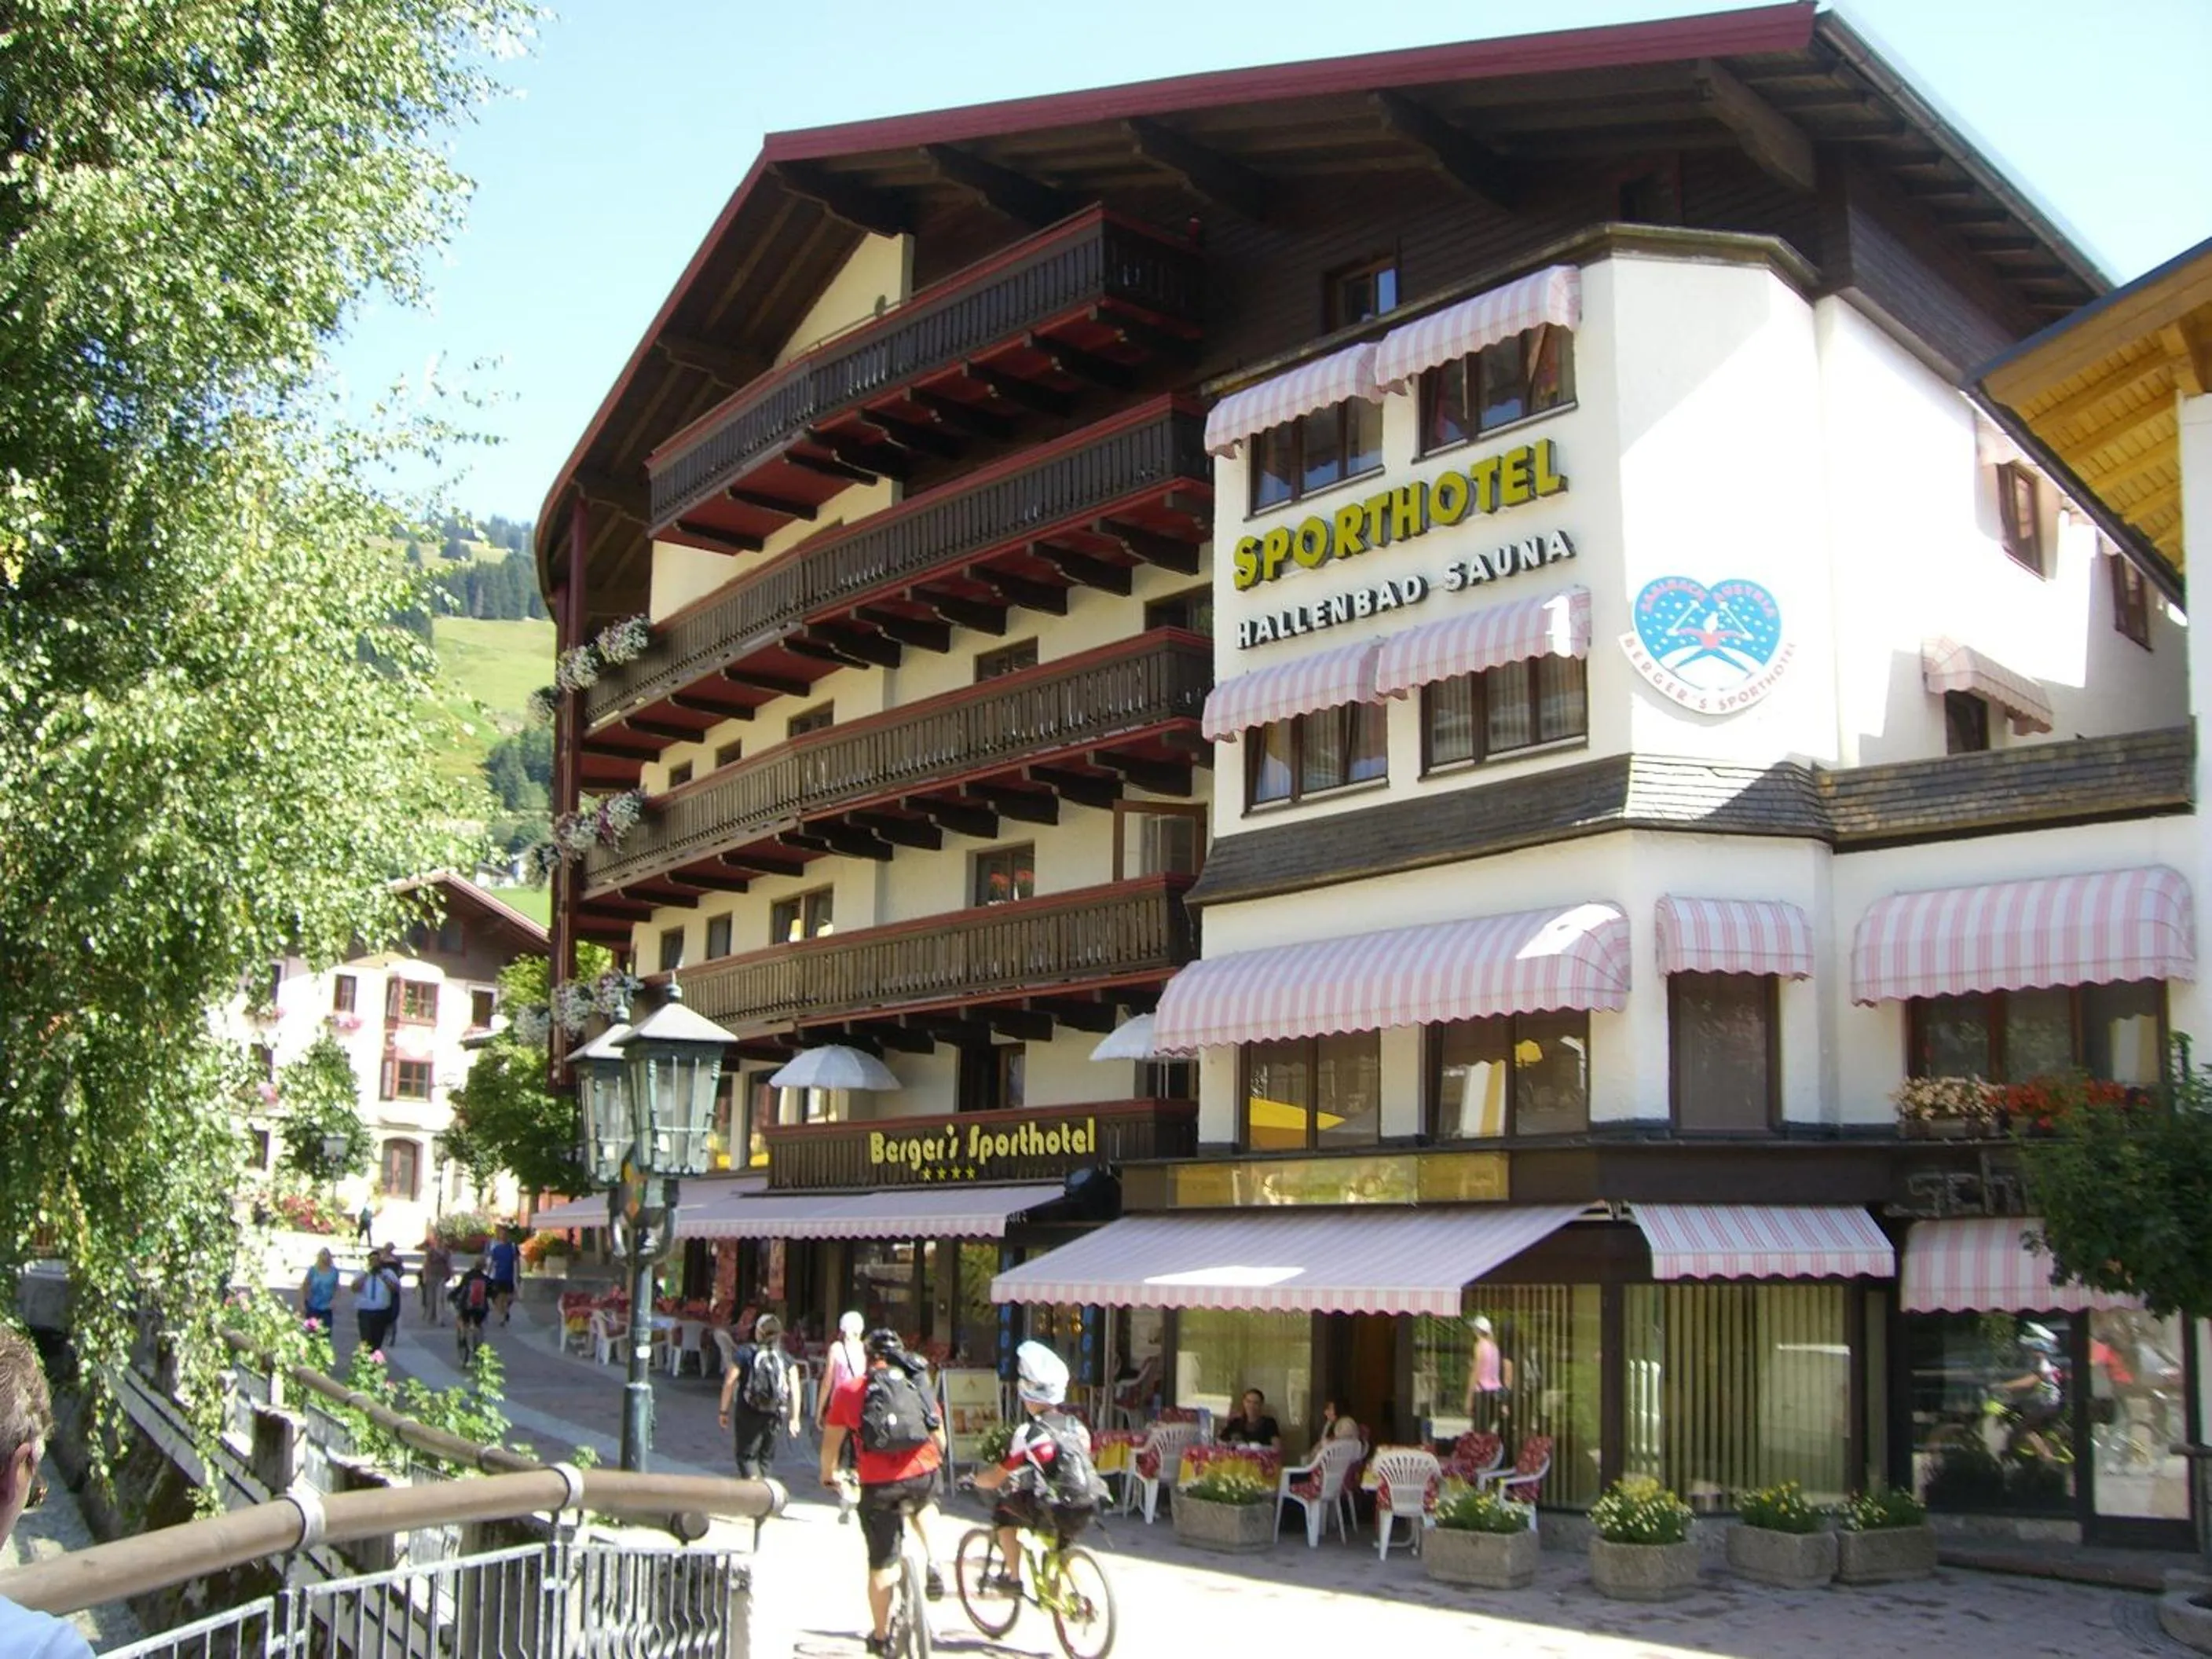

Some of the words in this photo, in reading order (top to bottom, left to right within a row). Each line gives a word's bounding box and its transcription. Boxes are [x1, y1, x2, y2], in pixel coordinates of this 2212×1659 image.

[1233, 438, 1568, 591] SPORTHOTEL
[1236, 575, 1428, 650] HALLENBAD
[1442, 529, 1574, 592] SAUNA
[1717, 641, 1797, 712] SPORTHOTEL
[870, 1122, 959, 1171] Berger's
[967, 1116, 1097, 1166] Sporthotel
